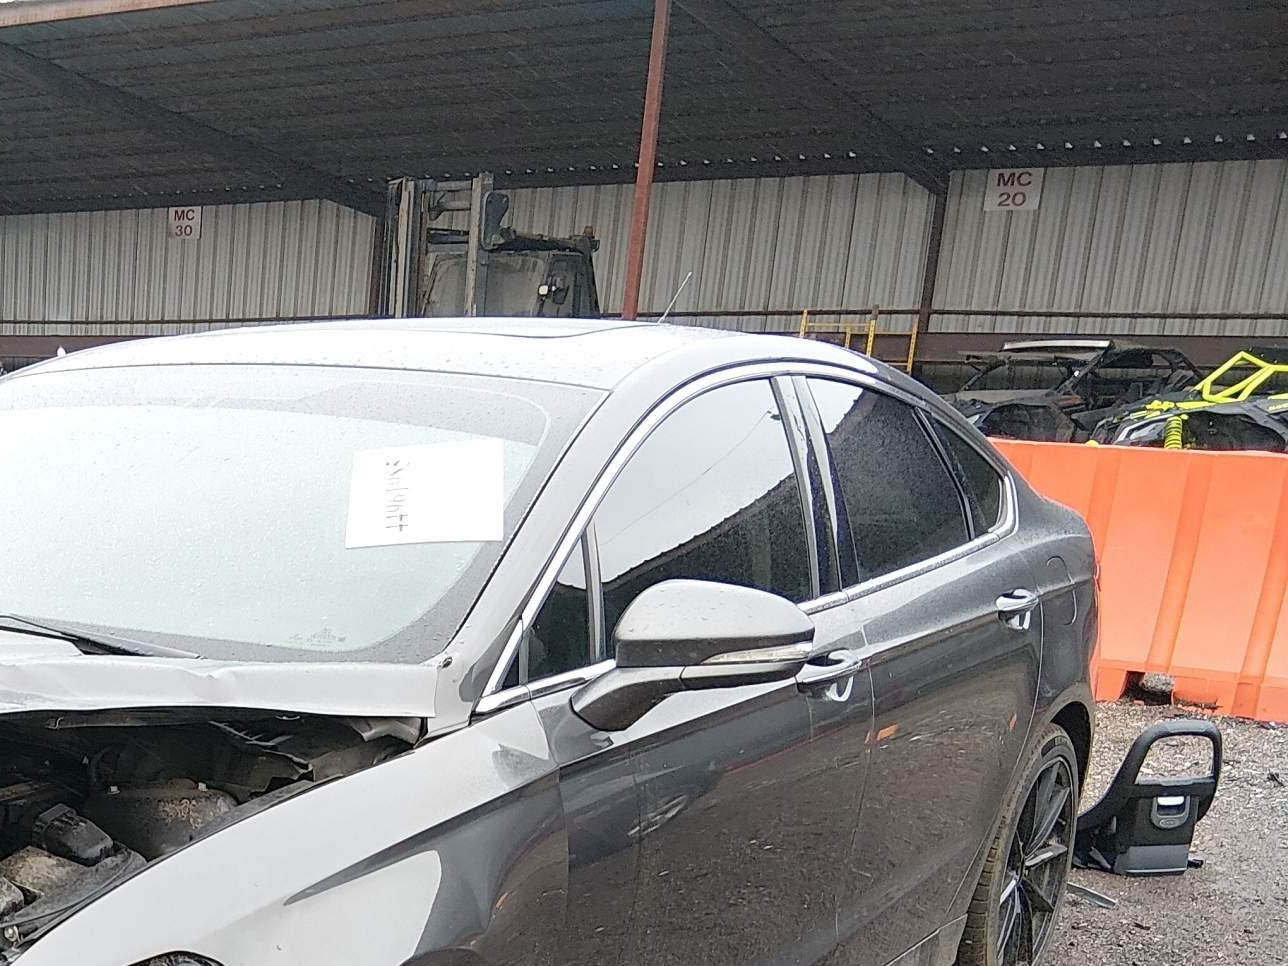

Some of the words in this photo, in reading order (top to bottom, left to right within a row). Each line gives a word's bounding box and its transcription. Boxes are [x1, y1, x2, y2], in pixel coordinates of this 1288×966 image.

[997, 171, 1032, 187] MC
[998, 191, 1027, 207] 20
[174, 208, 195, 221] MC
[175, 224, 193, 237] 30
